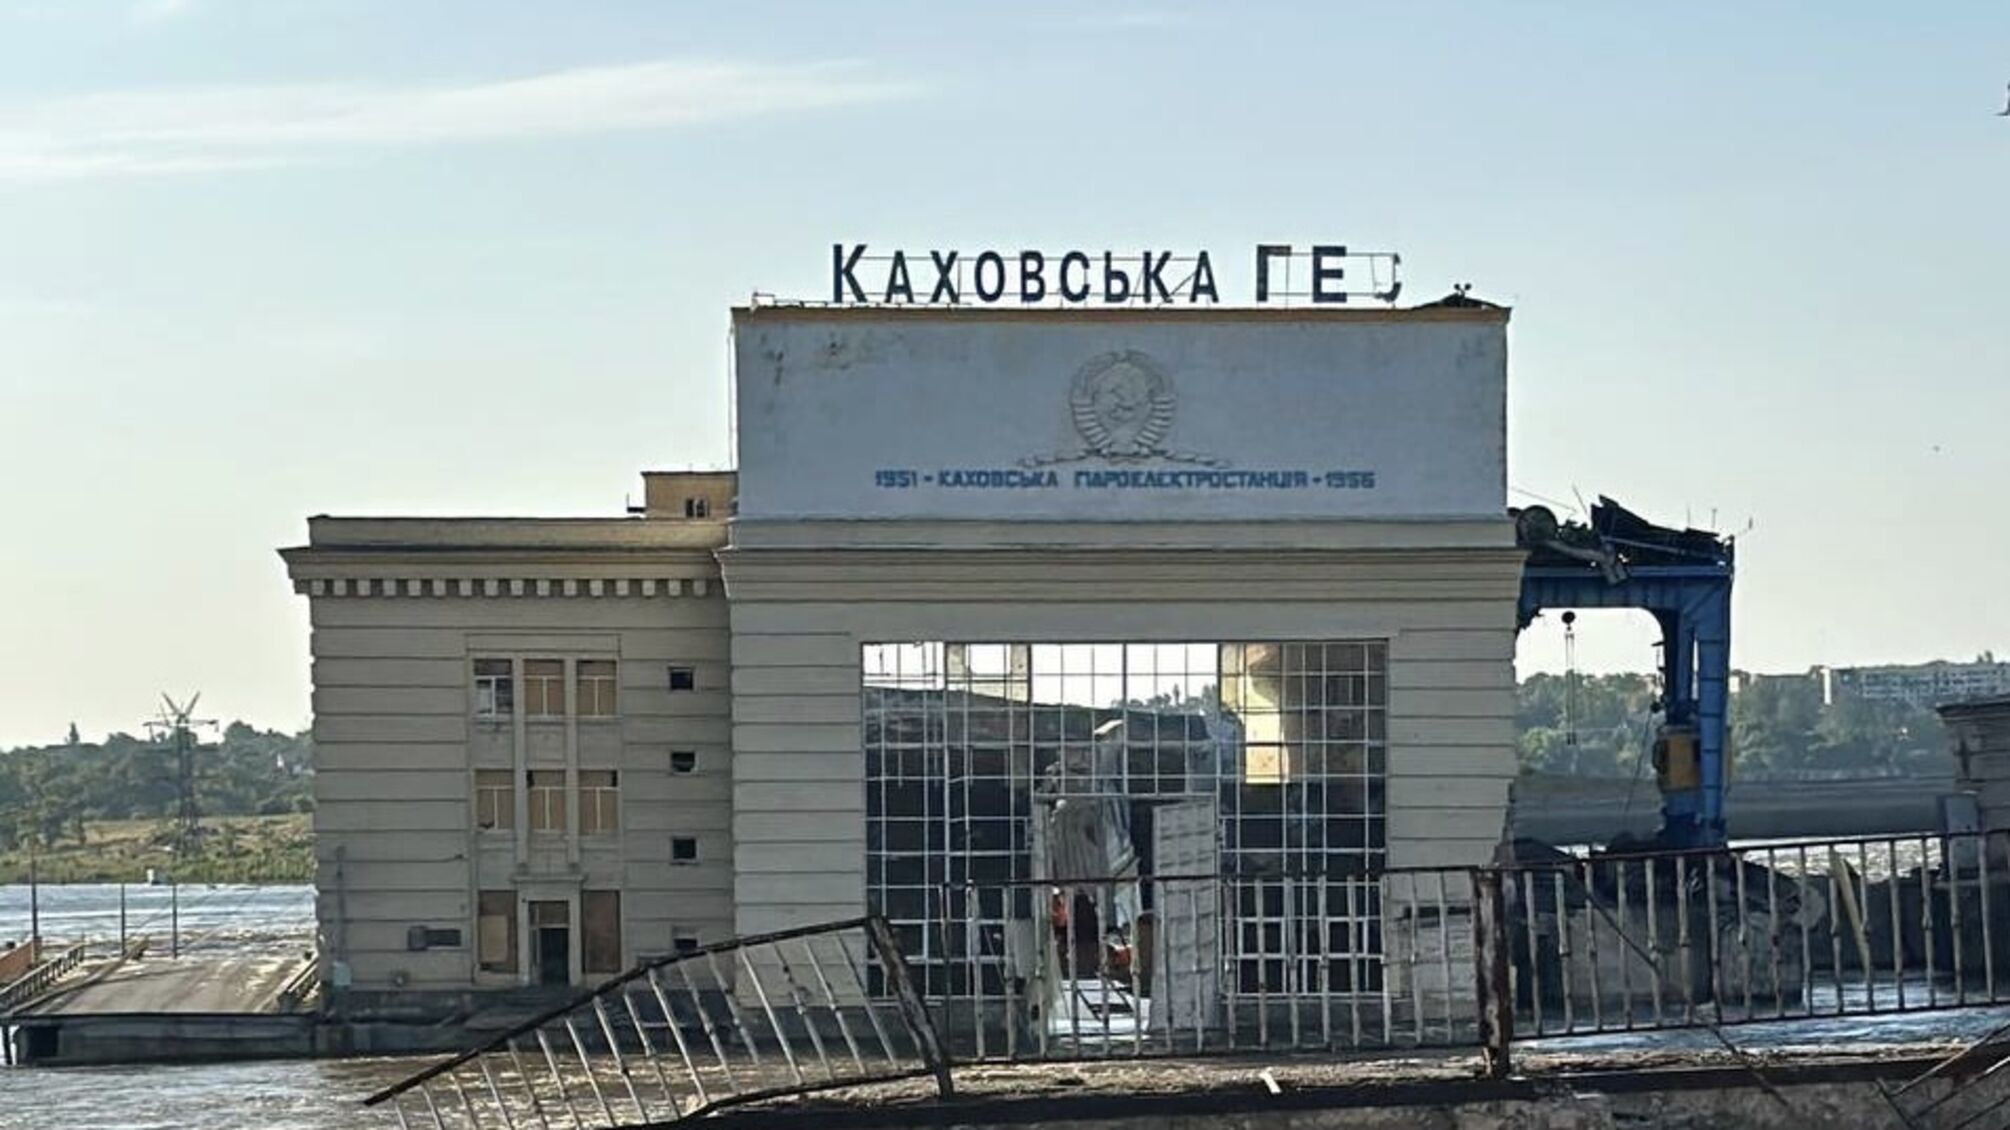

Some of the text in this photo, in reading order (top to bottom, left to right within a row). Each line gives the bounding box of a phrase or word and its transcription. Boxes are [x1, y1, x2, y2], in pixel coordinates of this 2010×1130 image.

[833, 244, 1219, 302] КАХОВСЬКА
[875, 470, 917, 488] 1951
[938, 470, 1058, 488] КАХОВСЬКА
[1325, 471, 1376, 489] 1956
